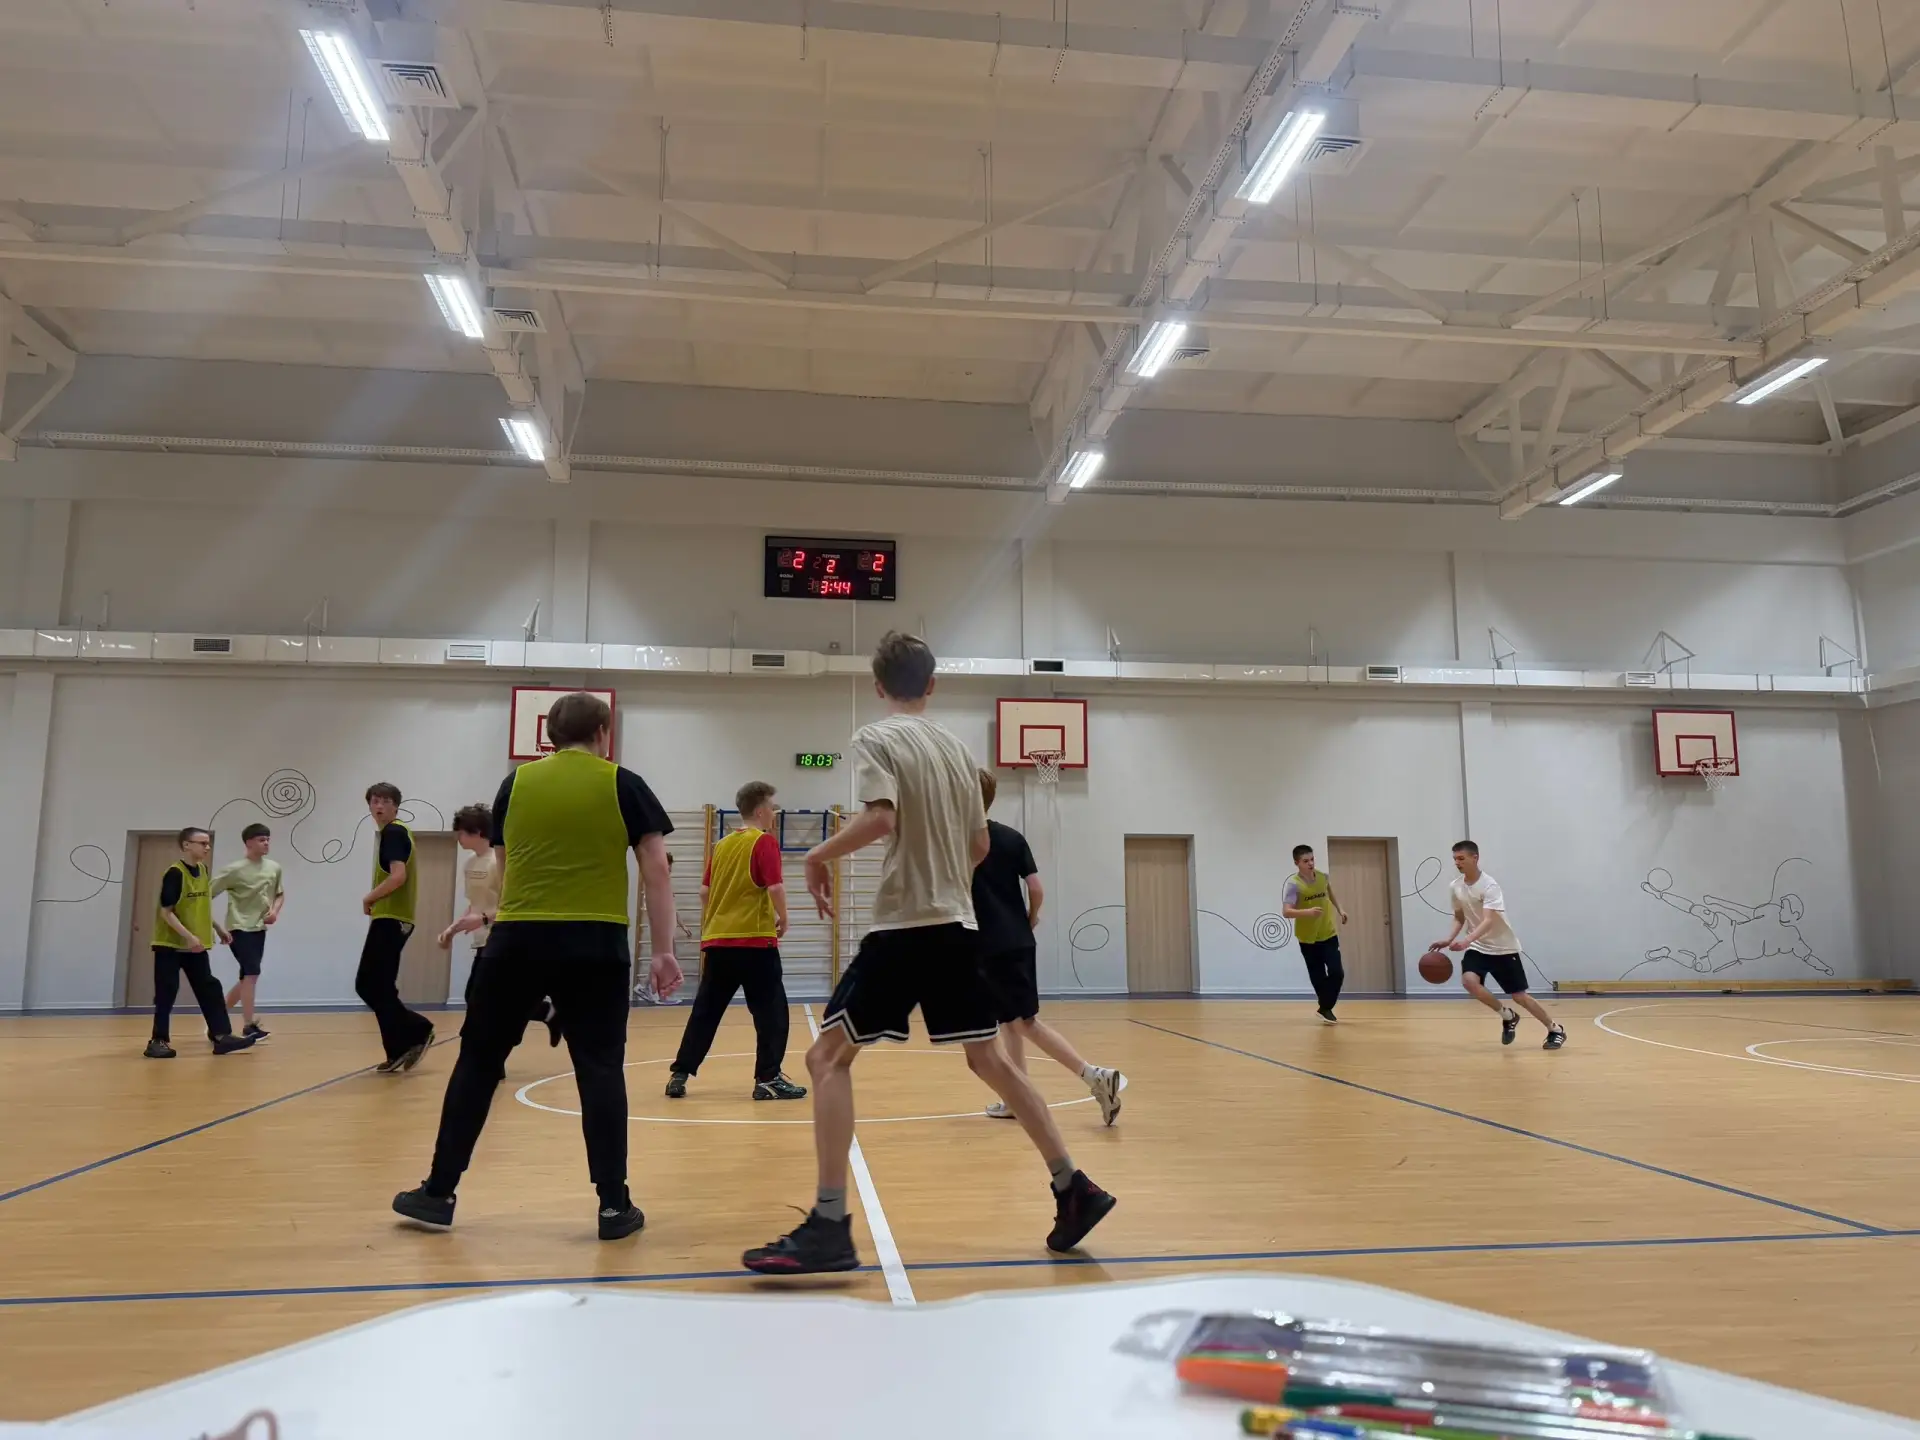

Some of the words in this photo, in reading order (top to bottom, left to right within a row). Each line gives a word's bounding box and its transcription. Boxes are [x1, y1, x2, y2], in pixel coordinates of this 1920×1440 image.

[792, 551, 805, 568] 2
[826, 559, 836, 573] 2
[872, 554, 885, 571] 2
[820, 580, 851, 595] 3:44
[801, 754, 833, 766] 18.03
